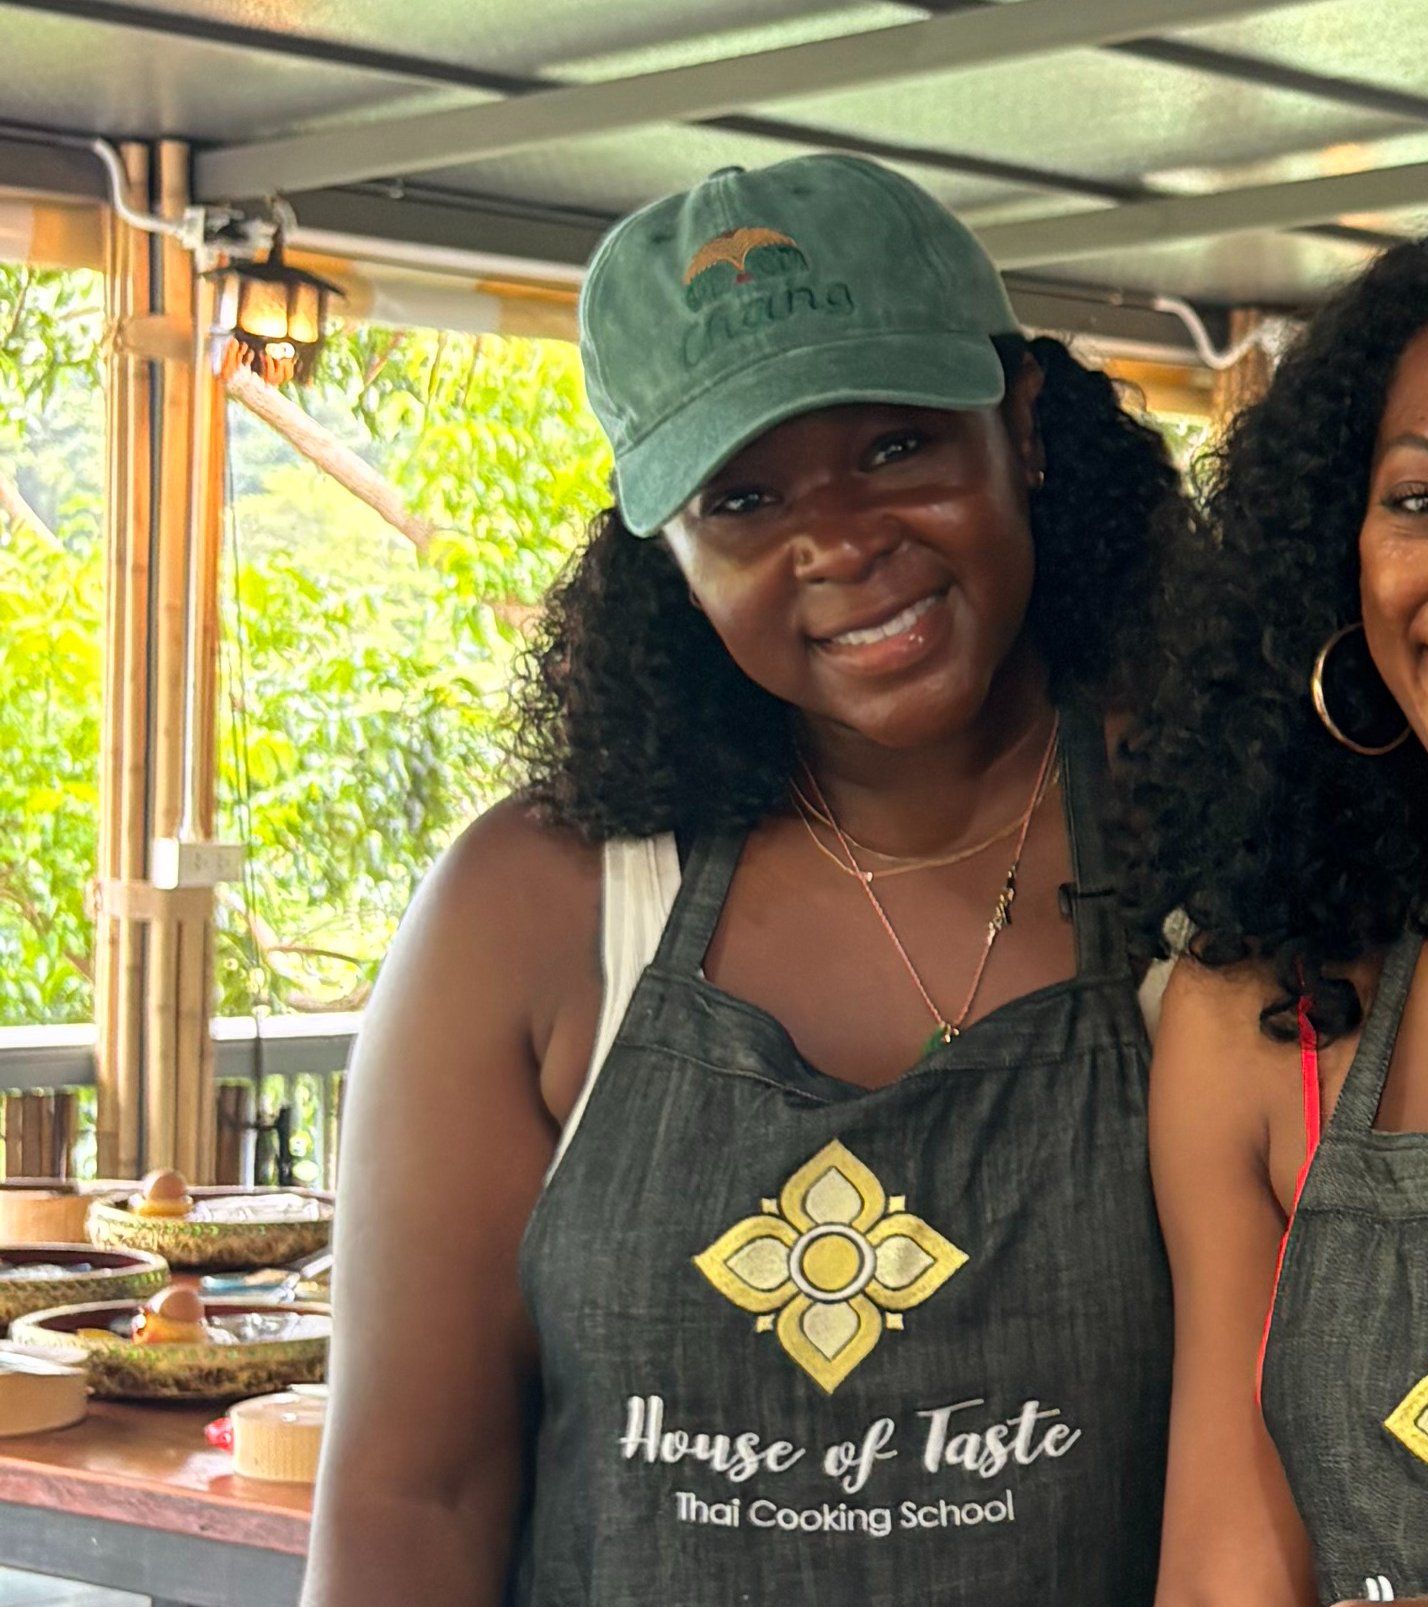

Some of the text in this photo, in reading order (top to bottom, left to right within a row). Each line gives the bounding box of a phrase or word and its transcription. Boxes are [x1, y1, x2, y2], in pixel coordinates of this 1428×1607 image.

[619, 1395, 1082, 1495] House of Taste
[675, 1489, 1015, 1538] Thai Cooking School
